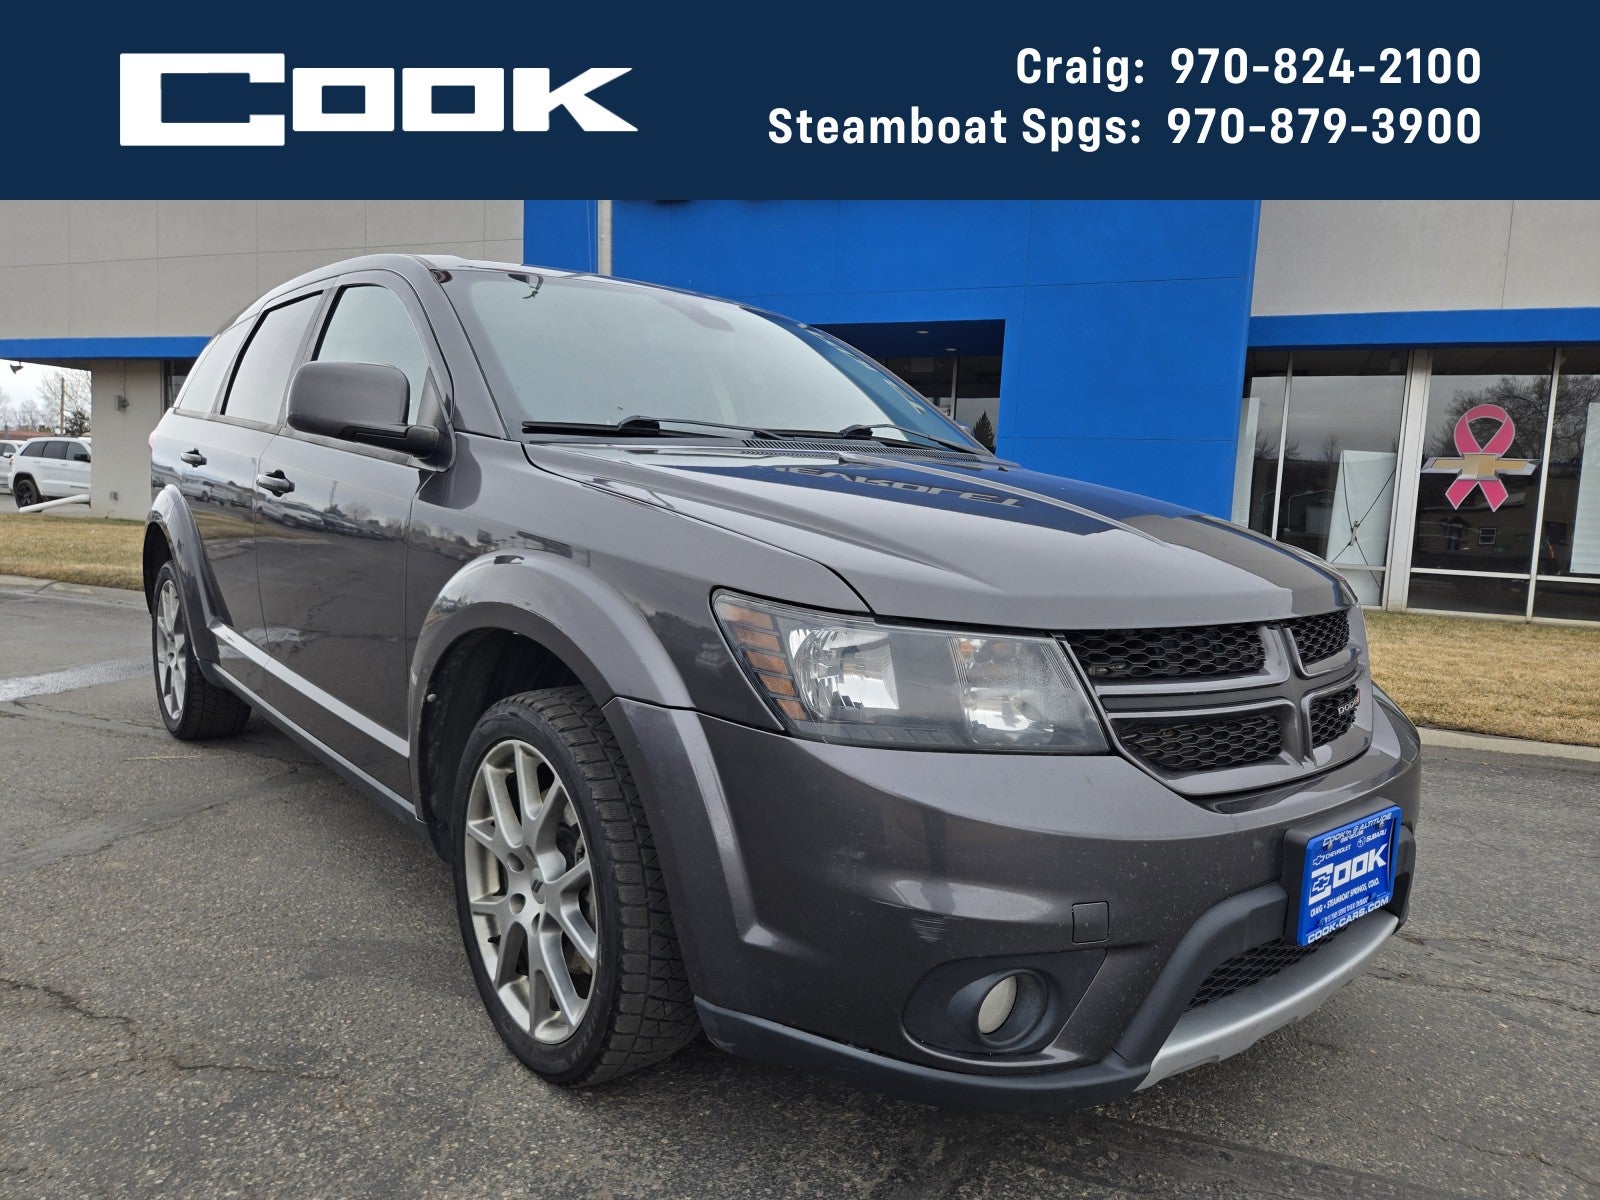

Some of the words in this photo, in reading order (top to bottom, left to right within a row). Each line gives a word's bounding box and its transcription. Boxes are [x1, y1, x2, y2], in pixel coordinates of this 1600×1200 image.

[1366, 829, 1387, 842] SUBARU
[1326, 845, 1351, 859] CHEVROLET
[1309, 843, 1388, 905] COOK
[1310, 904, 1323, 917] CRAIG
[1327, 892, 1350, 909] STEAMBOAT
